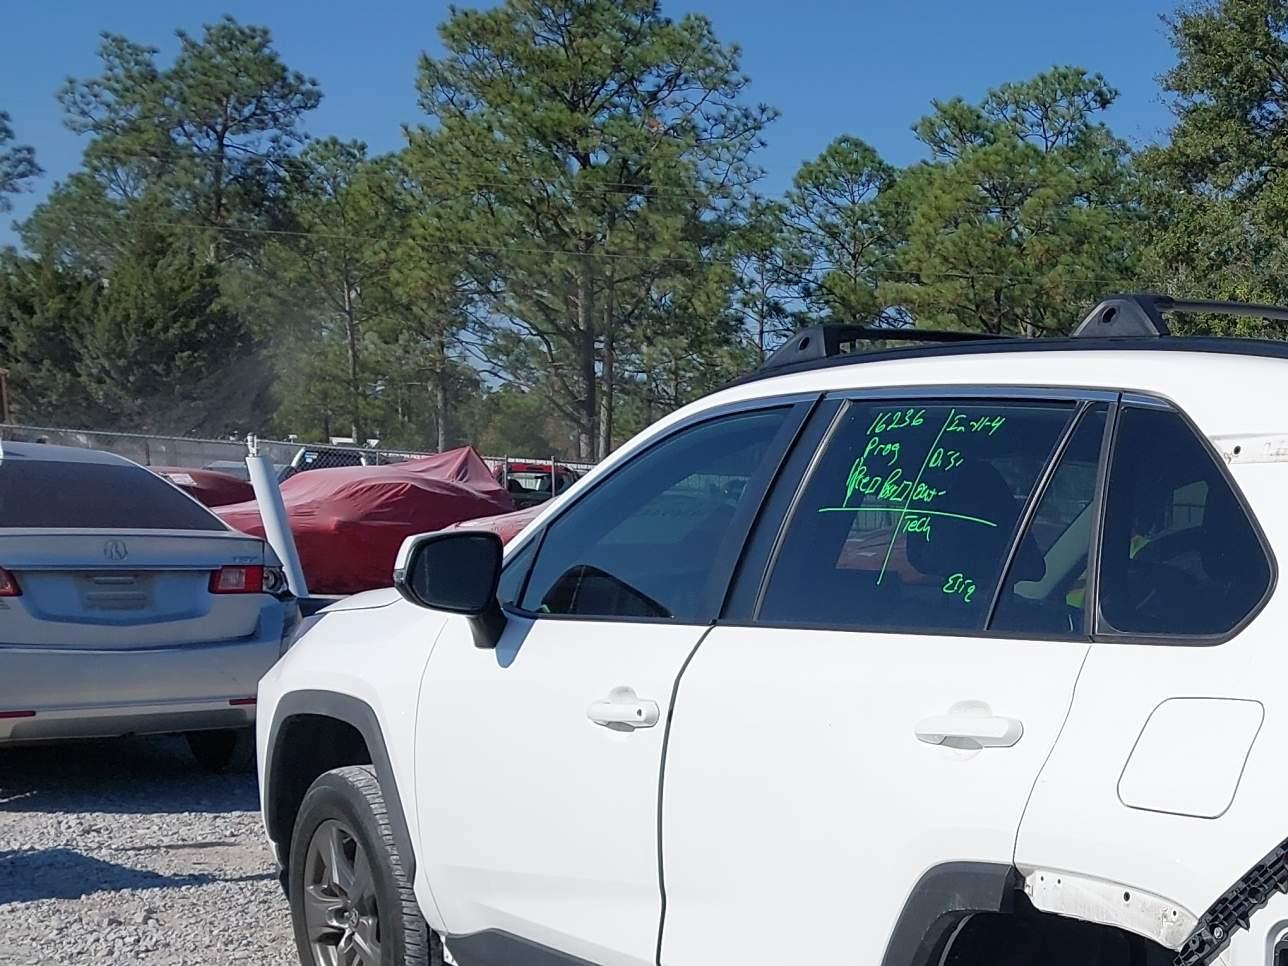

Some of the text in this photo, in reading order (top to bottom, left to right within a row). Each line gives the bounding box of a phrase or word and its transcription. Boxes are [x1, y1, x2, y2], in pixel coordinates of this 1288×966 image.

[866, 408, 926, 435] 16236
[863, 436, 900, 467] Prog
[903, 515, 931, 542] Tech
